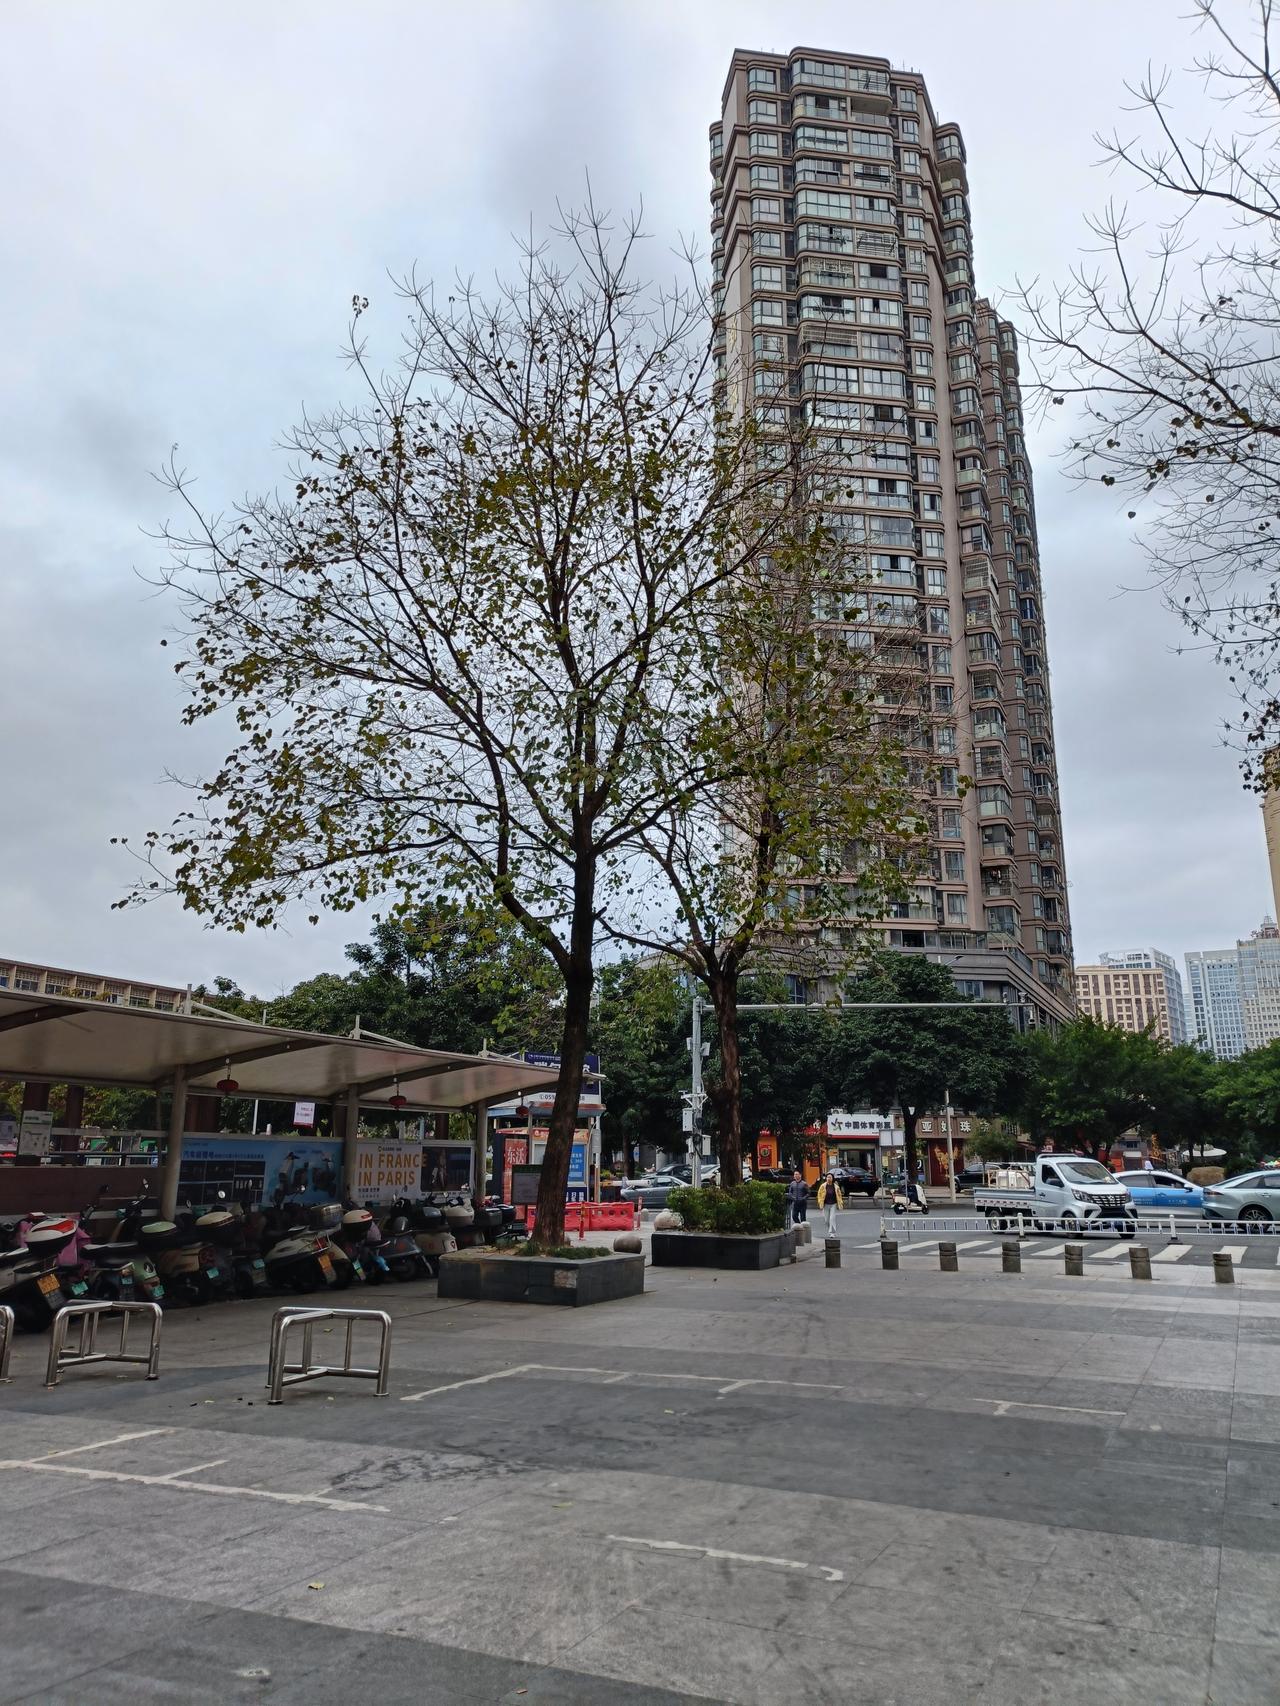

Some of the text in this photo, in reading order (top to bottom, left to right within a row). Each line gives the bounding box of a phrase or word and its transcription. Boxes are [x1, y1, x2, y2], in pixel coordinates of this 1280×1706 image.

[845, 1121, 891, 1130] 中国体育彩票
[359, 1153, 429, 1168] IN FRANCE
[358, 1170, 416, 1186] IN PARIS
